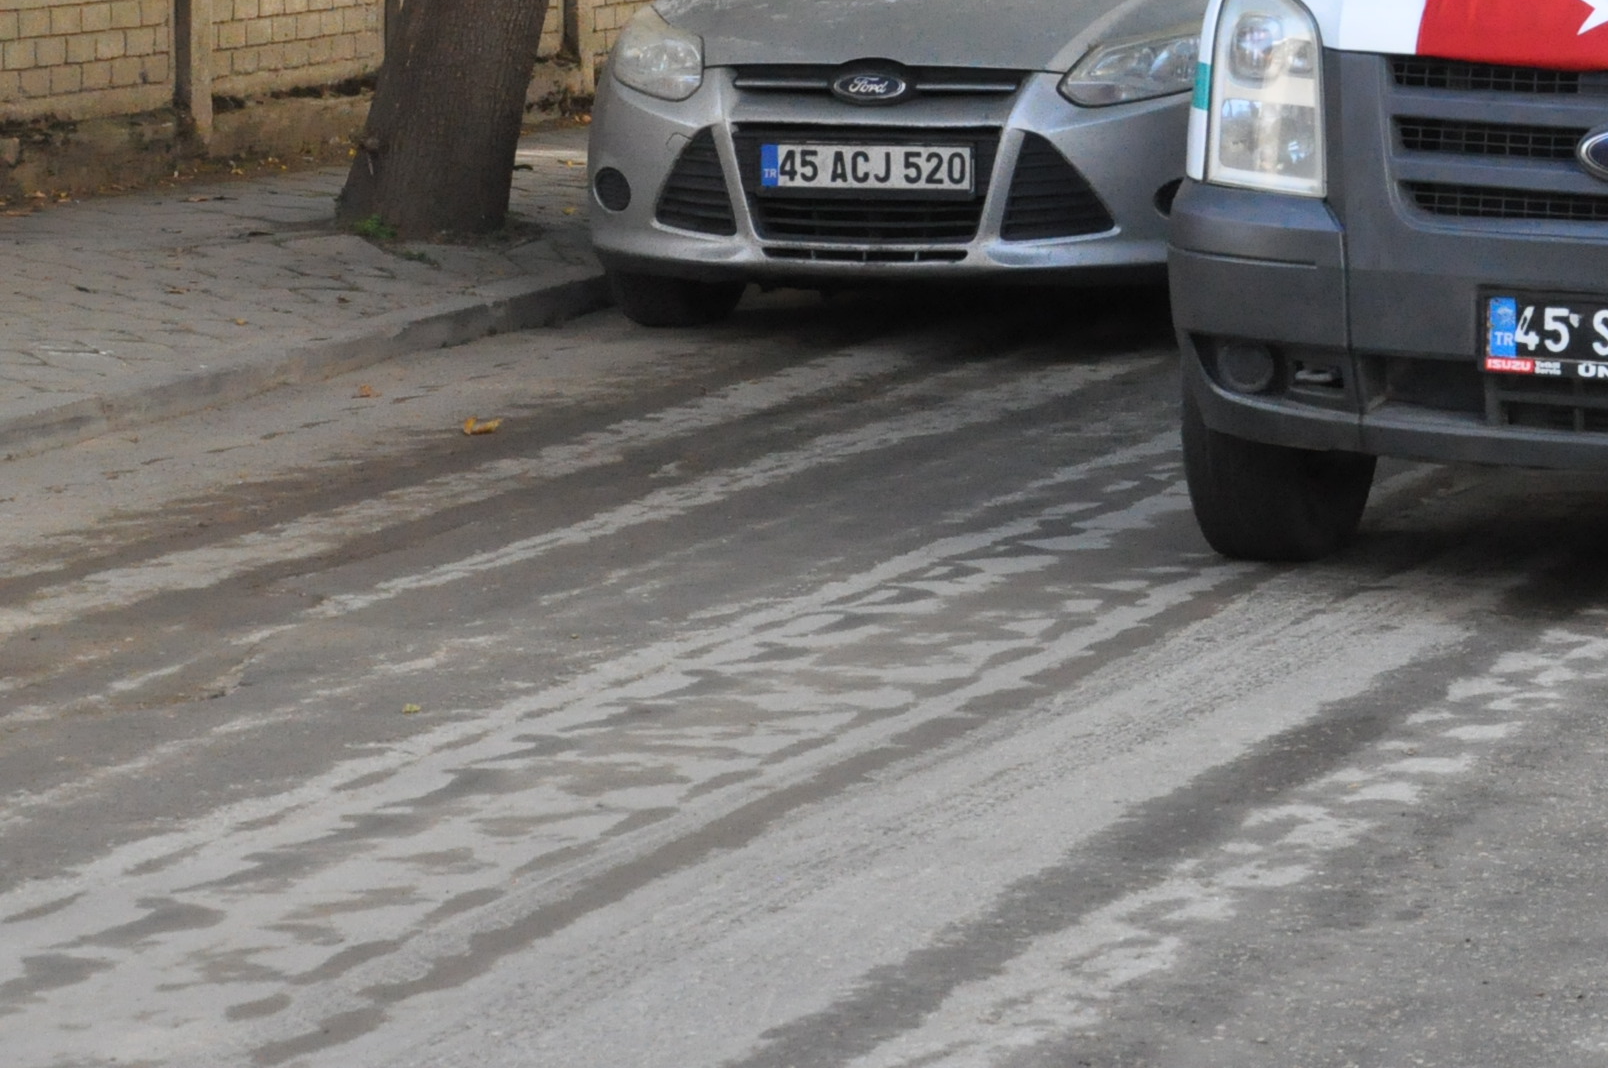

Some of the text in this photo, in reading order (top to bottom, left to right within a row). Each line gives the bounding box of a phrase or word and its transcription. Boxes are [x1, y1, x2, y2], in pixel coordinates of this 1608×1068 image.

[848, 76, 888, 93] Ford
[763, 168, 777, 178] TR
[779, 149, 966, 184] 45 ACJ 520
[1514, 305, 1570, 353] 45
[1493, 332, 1514, 346] TR
[1486, 358, 1532, 371] ISUZU
